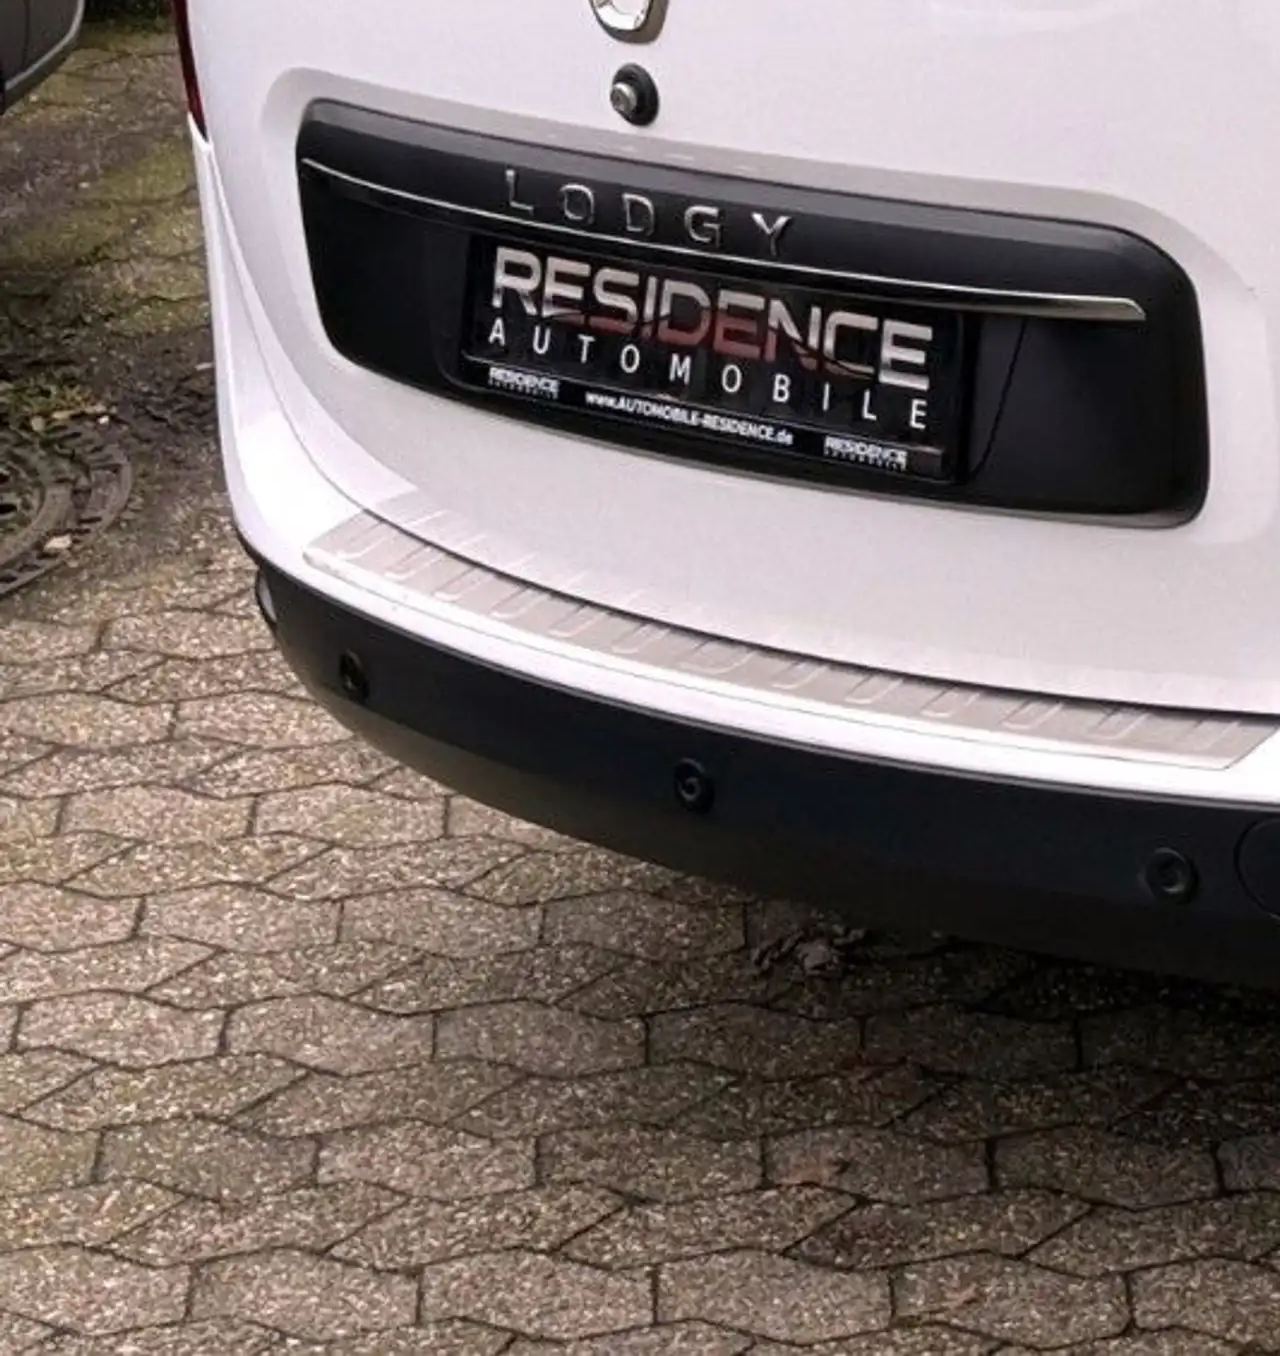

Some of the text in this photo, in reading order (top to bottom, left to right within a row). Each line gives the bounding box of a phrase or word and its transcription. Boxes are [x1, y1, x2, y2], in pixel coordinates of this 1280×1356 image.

[505, 167, 792, 256] LODGY
[488, 317, 928, 429] AUTOMOBILE
[492, 246, 933, 391] RESIDENCE
